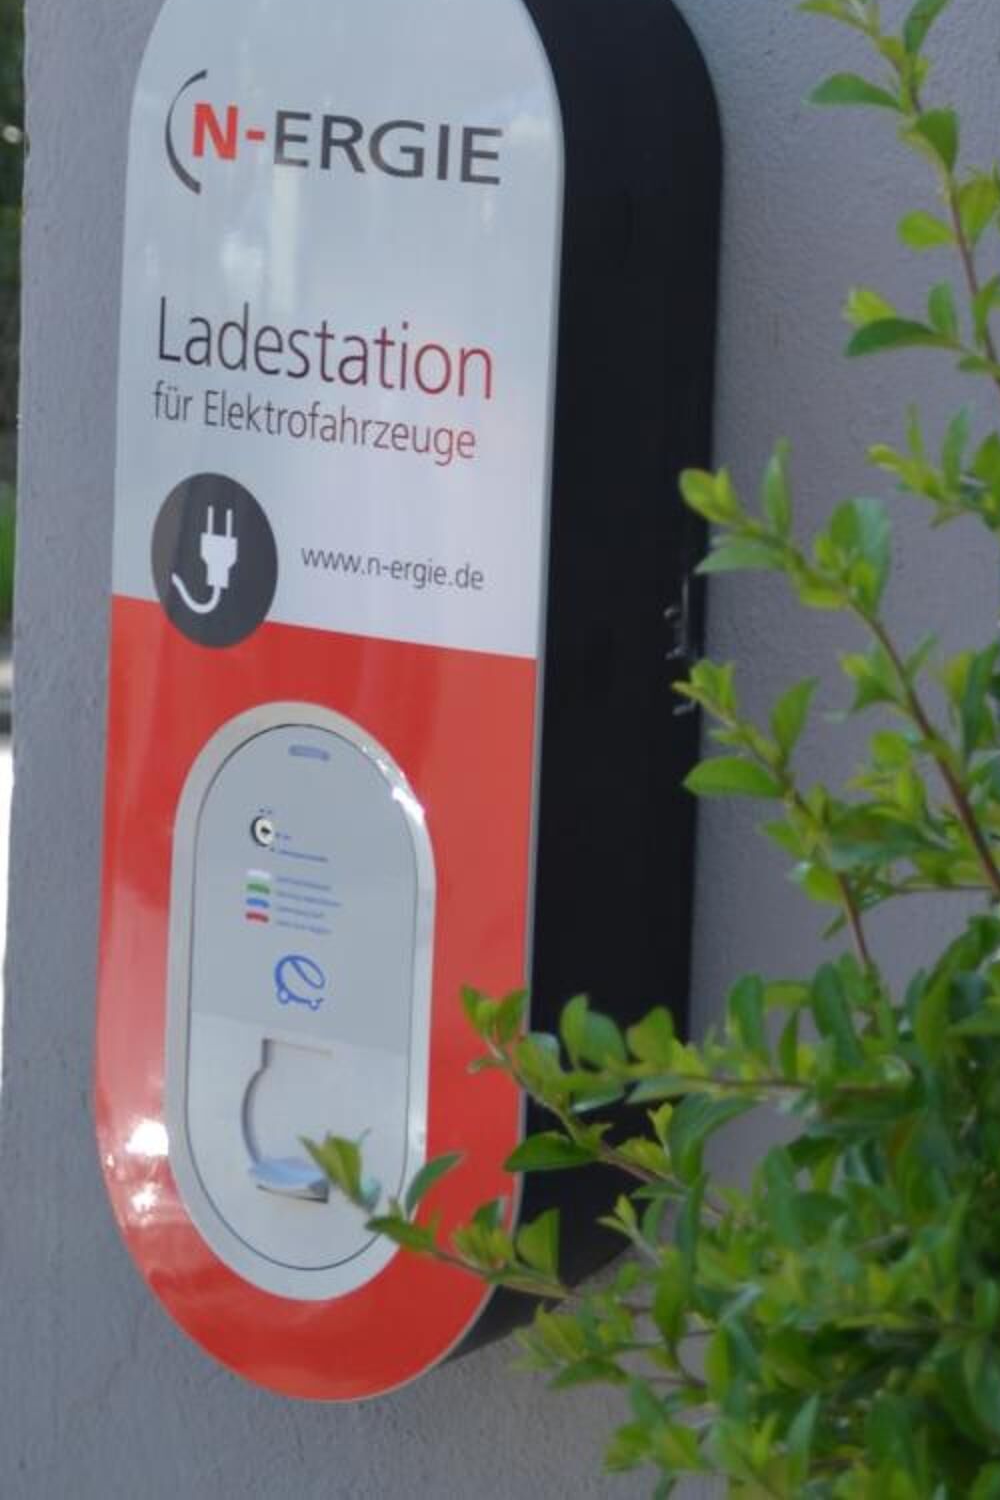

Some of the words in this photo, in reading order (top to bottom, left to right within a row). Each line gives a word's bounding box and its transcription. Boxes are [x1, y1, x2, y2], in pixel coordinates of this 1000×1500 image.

[192, 102, 504, 186] N-ERGIE
[157, 295, 494, 400] Ladestation
[151, 380, 194, 421] für
[203, 389, 477, 467] Elektrofahrzeuge
[300, 547, 485, 591] www.n-ergie.de
